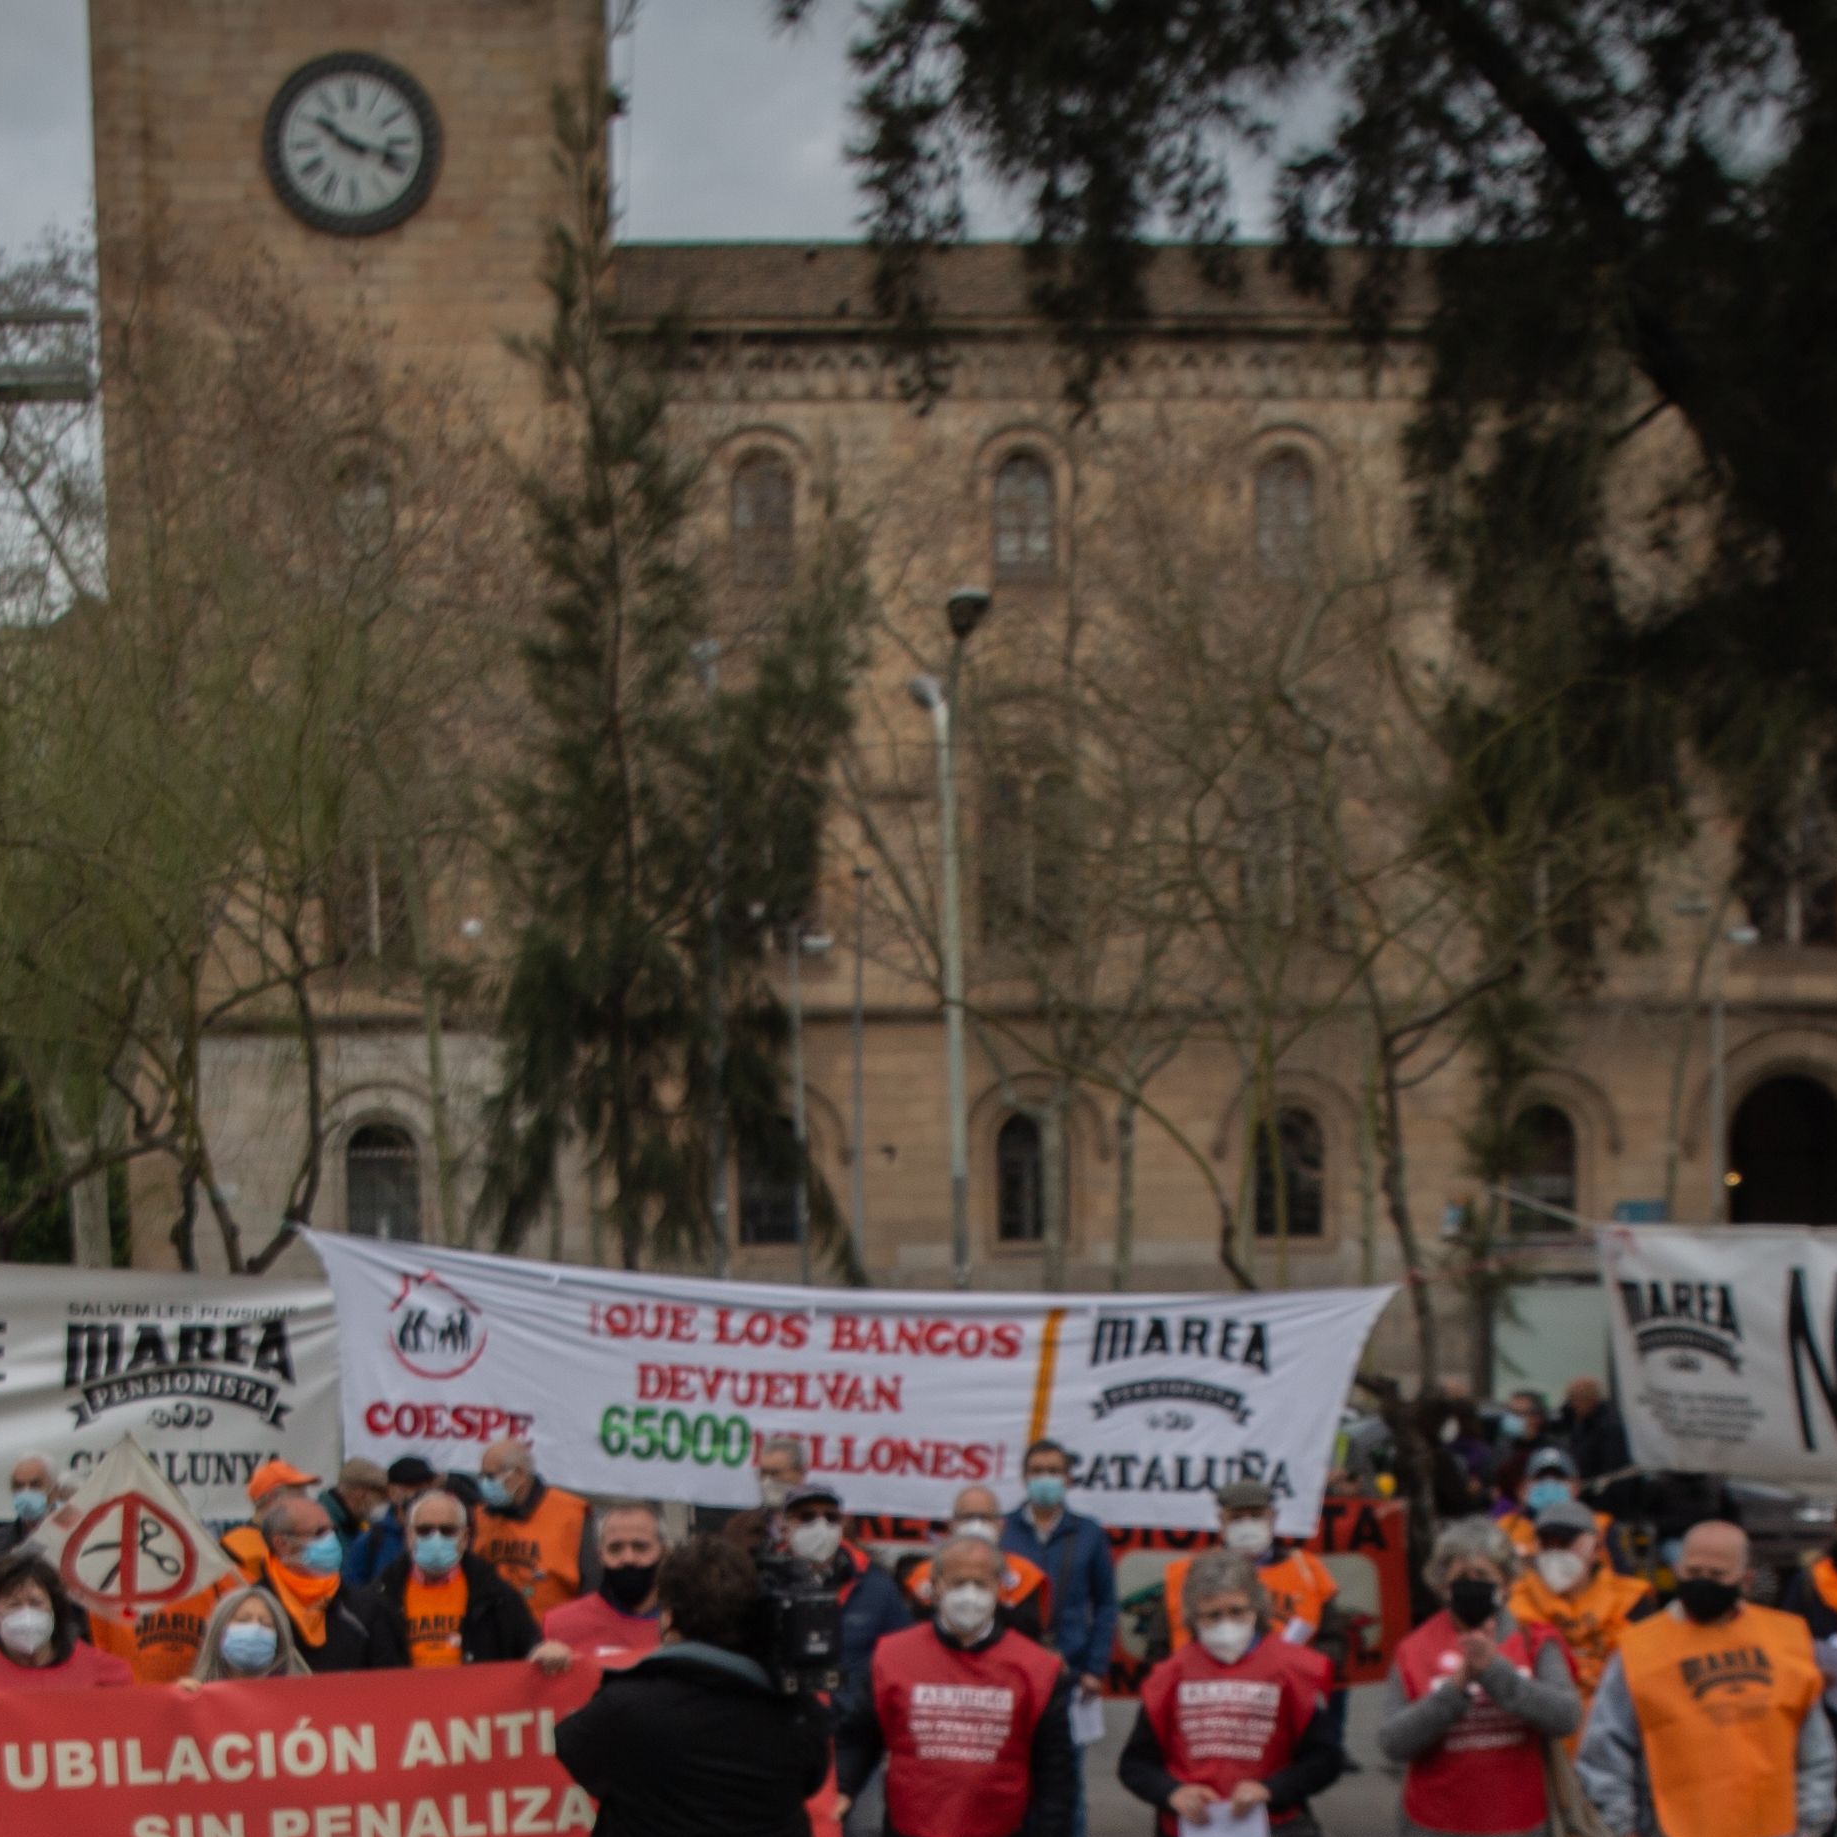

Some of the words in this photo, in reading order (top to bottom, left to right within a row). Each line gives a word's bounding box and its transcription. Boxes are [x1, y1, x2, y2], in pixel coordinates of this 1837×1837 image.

[67, 1301, 151, 1319] SALVEM
[156, 1303, 194, 1320] LES
[714, 1306, 811, 1349] LOS
[64, 1319, 296, 1389] MAREA
[1089, 1315, 1270, 1376] MAREA
[92, 1371, 270, 1408] PENSIONISTA
[637, 1362, 903, 1413] DEVUELVAN
[365, 1401, 534, 1448] COESPE
[600, 1404, 751, 1467] 65000
[400, 1707, 557, 1770] ANTI
